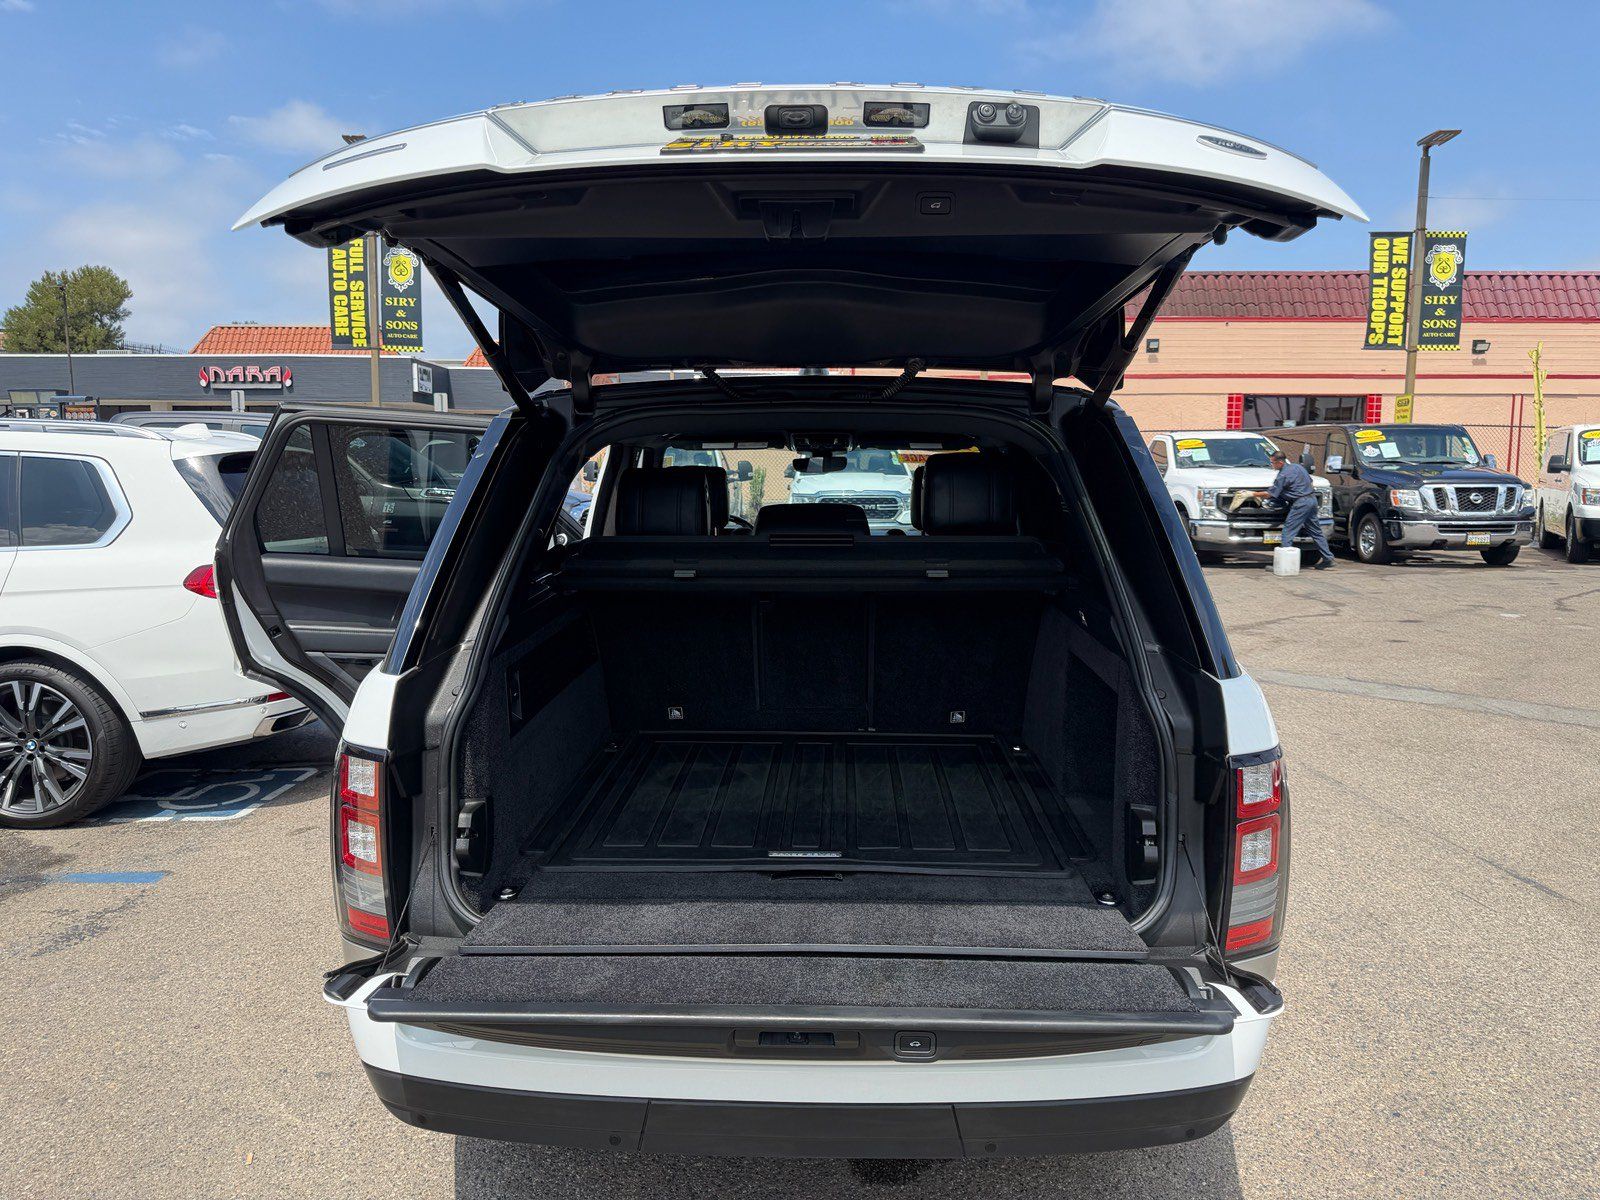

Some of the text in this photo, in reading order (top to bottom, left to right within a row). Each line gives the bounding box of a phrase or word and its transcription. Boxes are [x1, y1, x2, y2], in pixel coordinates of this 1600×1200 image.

[332, 249, 349, 336] AUTO CARE
[349, 238, 367, 347] FULL SERVICE
[1368, 238, 1390, 345] OUR TROOPS
[1387, 237, 1409, 346] WE SUPPORT
[385, 297, 416, 307] SIRY
[1424, 295, 1457, 305] SIRY
[396, 309, 407, 318] &
[1435, 308, 1446, 316] &
[386, 320, 418, 330] SONS
[1422, 319, 1456, 329] SONS
